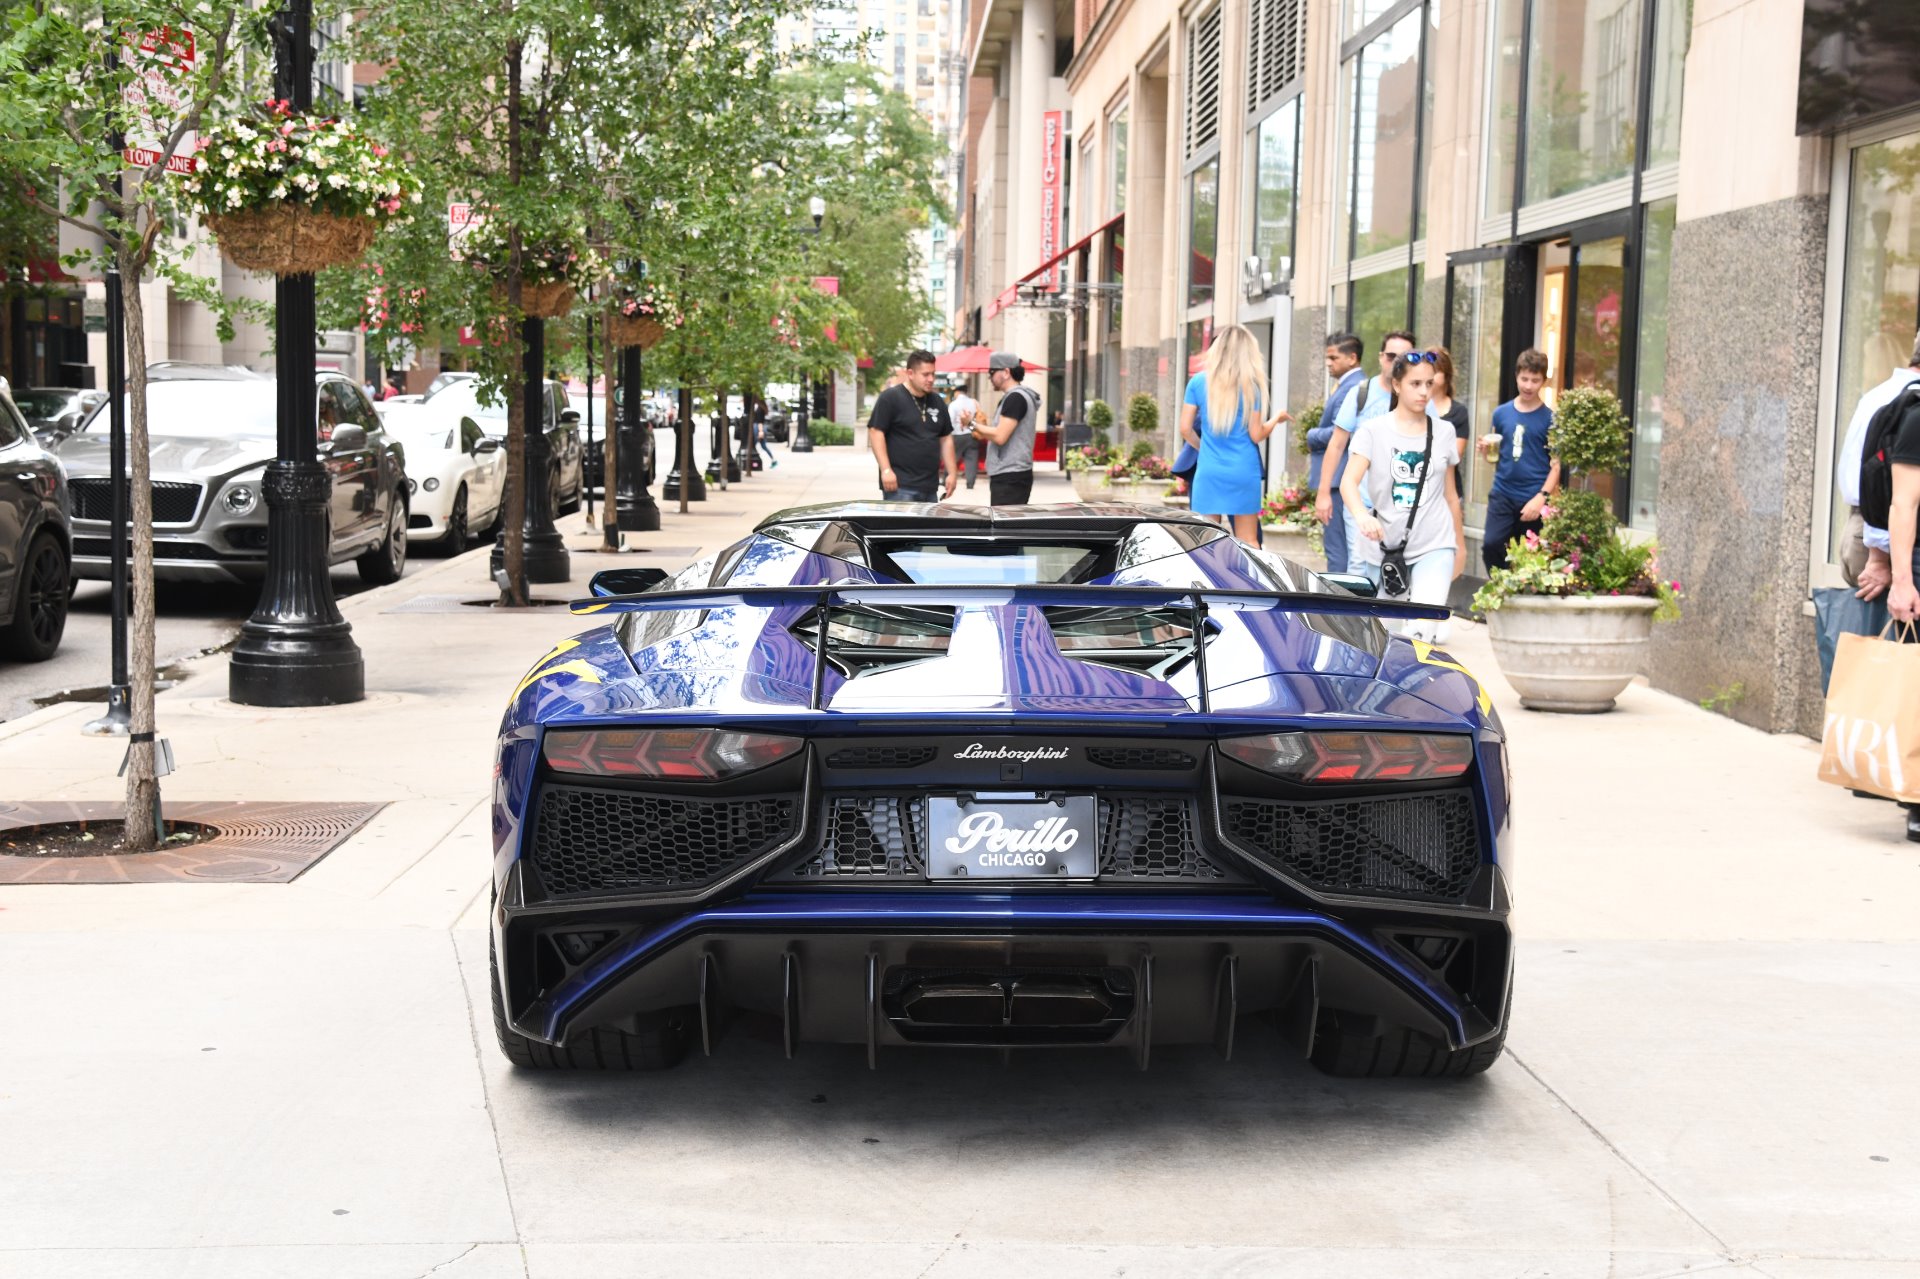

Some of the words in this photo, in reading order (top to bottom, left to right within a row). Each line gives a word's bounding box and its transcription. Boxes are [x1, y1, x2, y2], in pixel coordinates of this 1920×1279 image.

[129, 149, 154, 165] TOW
[167, 156, 191, 173] ONE
[1044, 118, 1056, 183] EPIC
[954, 743, 1069, 762] Lamborghini
[945, 811, 1079, 853] Perillo
[978, 853, 1046, 867] CHICAGO
